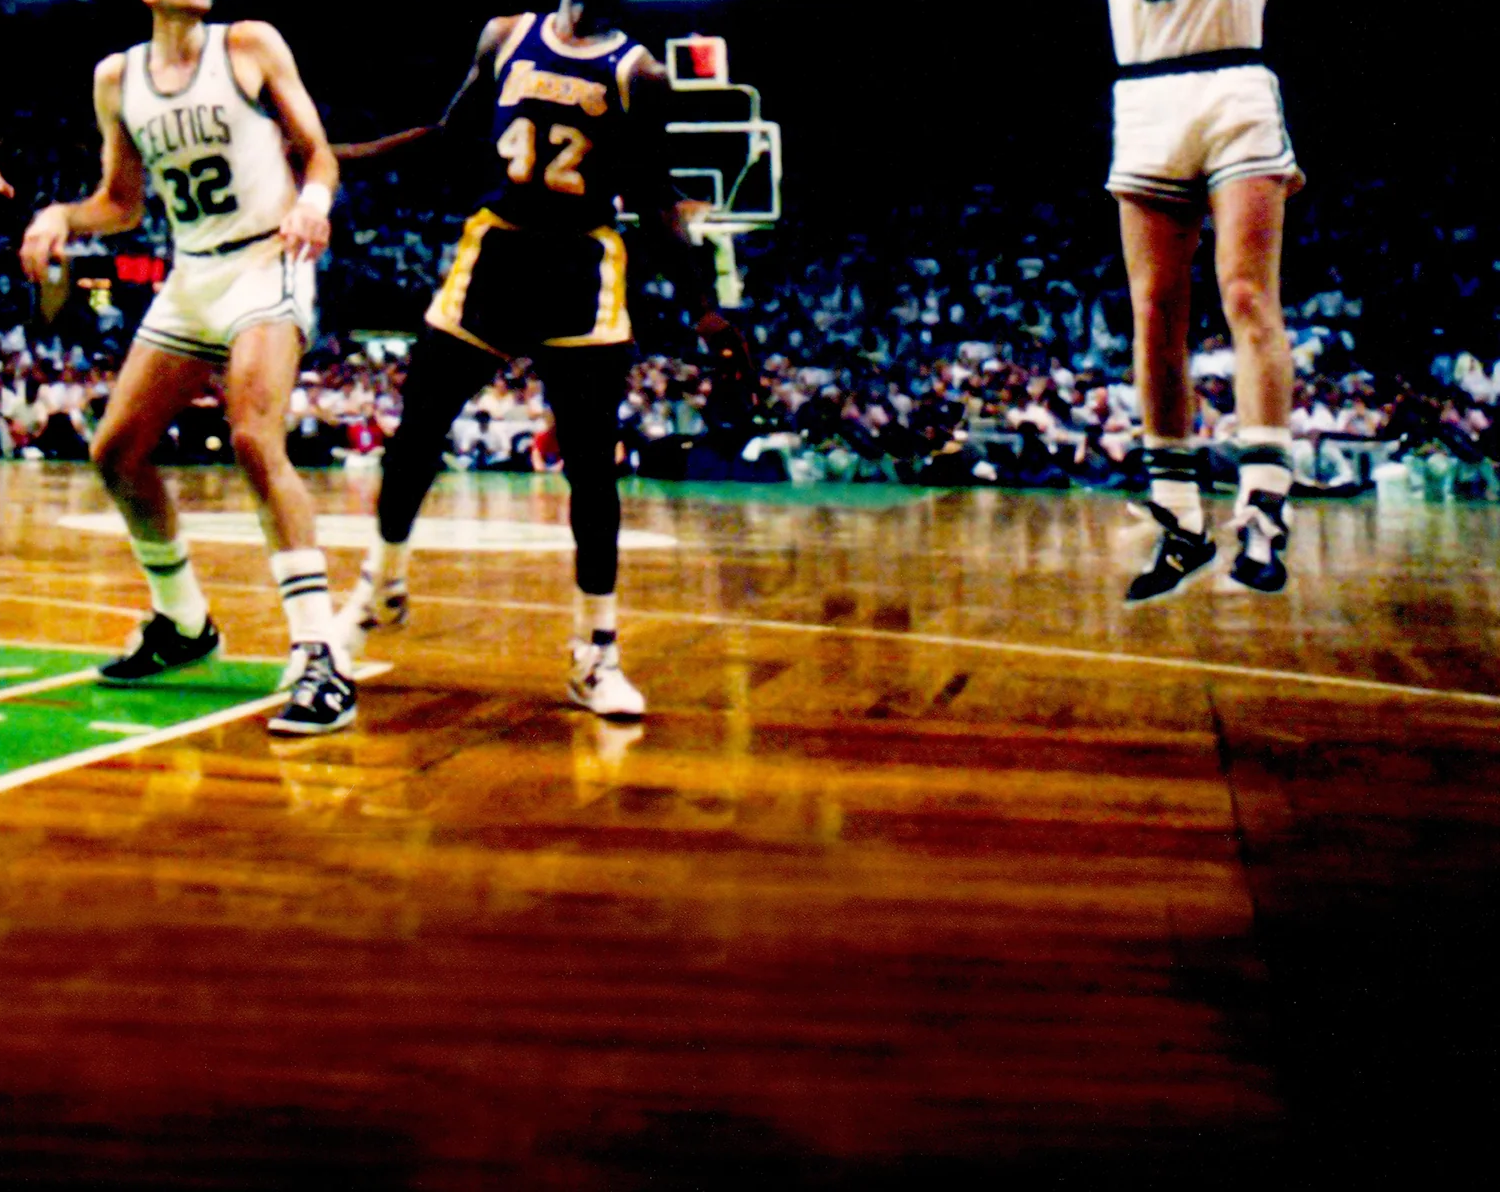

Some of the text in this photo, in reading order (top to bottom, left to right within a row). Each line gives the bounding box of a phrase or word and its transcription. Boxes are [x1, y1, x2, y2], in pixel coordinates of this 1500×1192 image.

[134, 105, 231, 166] CELTICS
[496, 117, 593, 196] 42
[162, 153, 239, 223] 32
